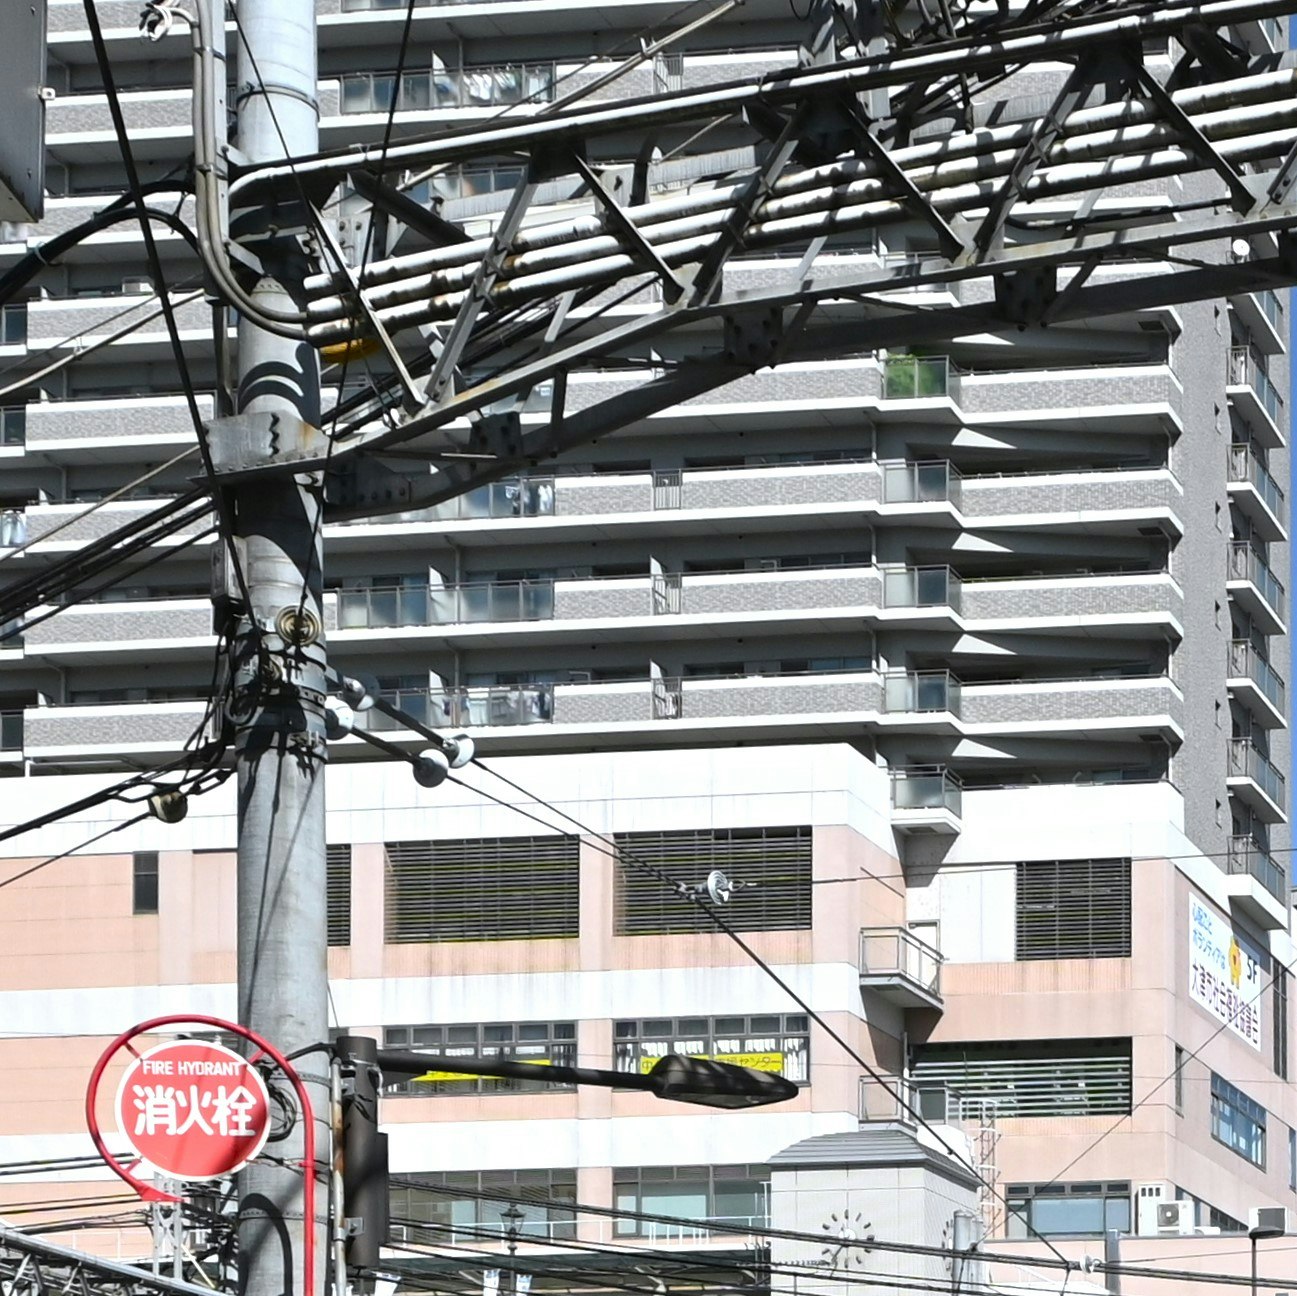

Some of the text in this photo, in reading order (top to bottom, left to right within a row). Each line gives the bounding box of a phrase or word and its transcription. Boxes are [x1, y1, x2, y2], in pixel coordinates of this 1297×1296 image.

[1246, 954, 1258, 984] 5F
[143, 1061, 241, 1076] FIRE HYDRANT
[132, 1084, 257, 1136] 消火栓
